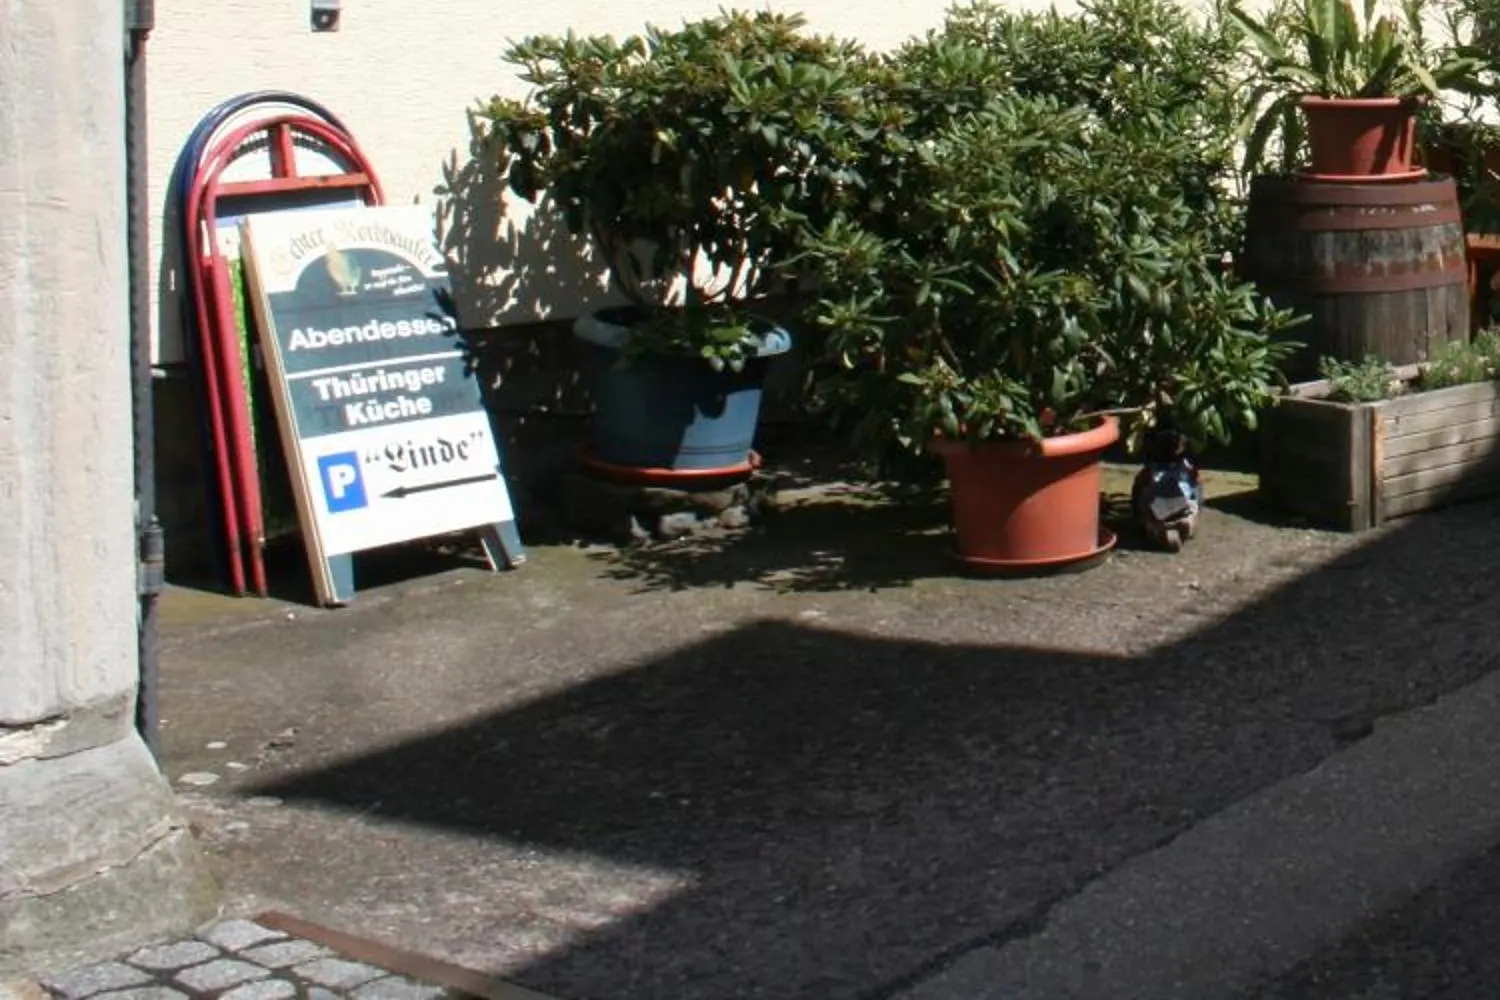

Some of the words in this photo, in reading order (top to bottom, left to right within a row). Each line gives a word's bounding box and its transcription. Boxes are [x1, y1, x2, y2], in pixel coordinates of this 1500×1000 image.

[312, 365, 446, 401] Thüringer
[345, 396, 433, 426] Küche
[327, 463, 357, 500] P
